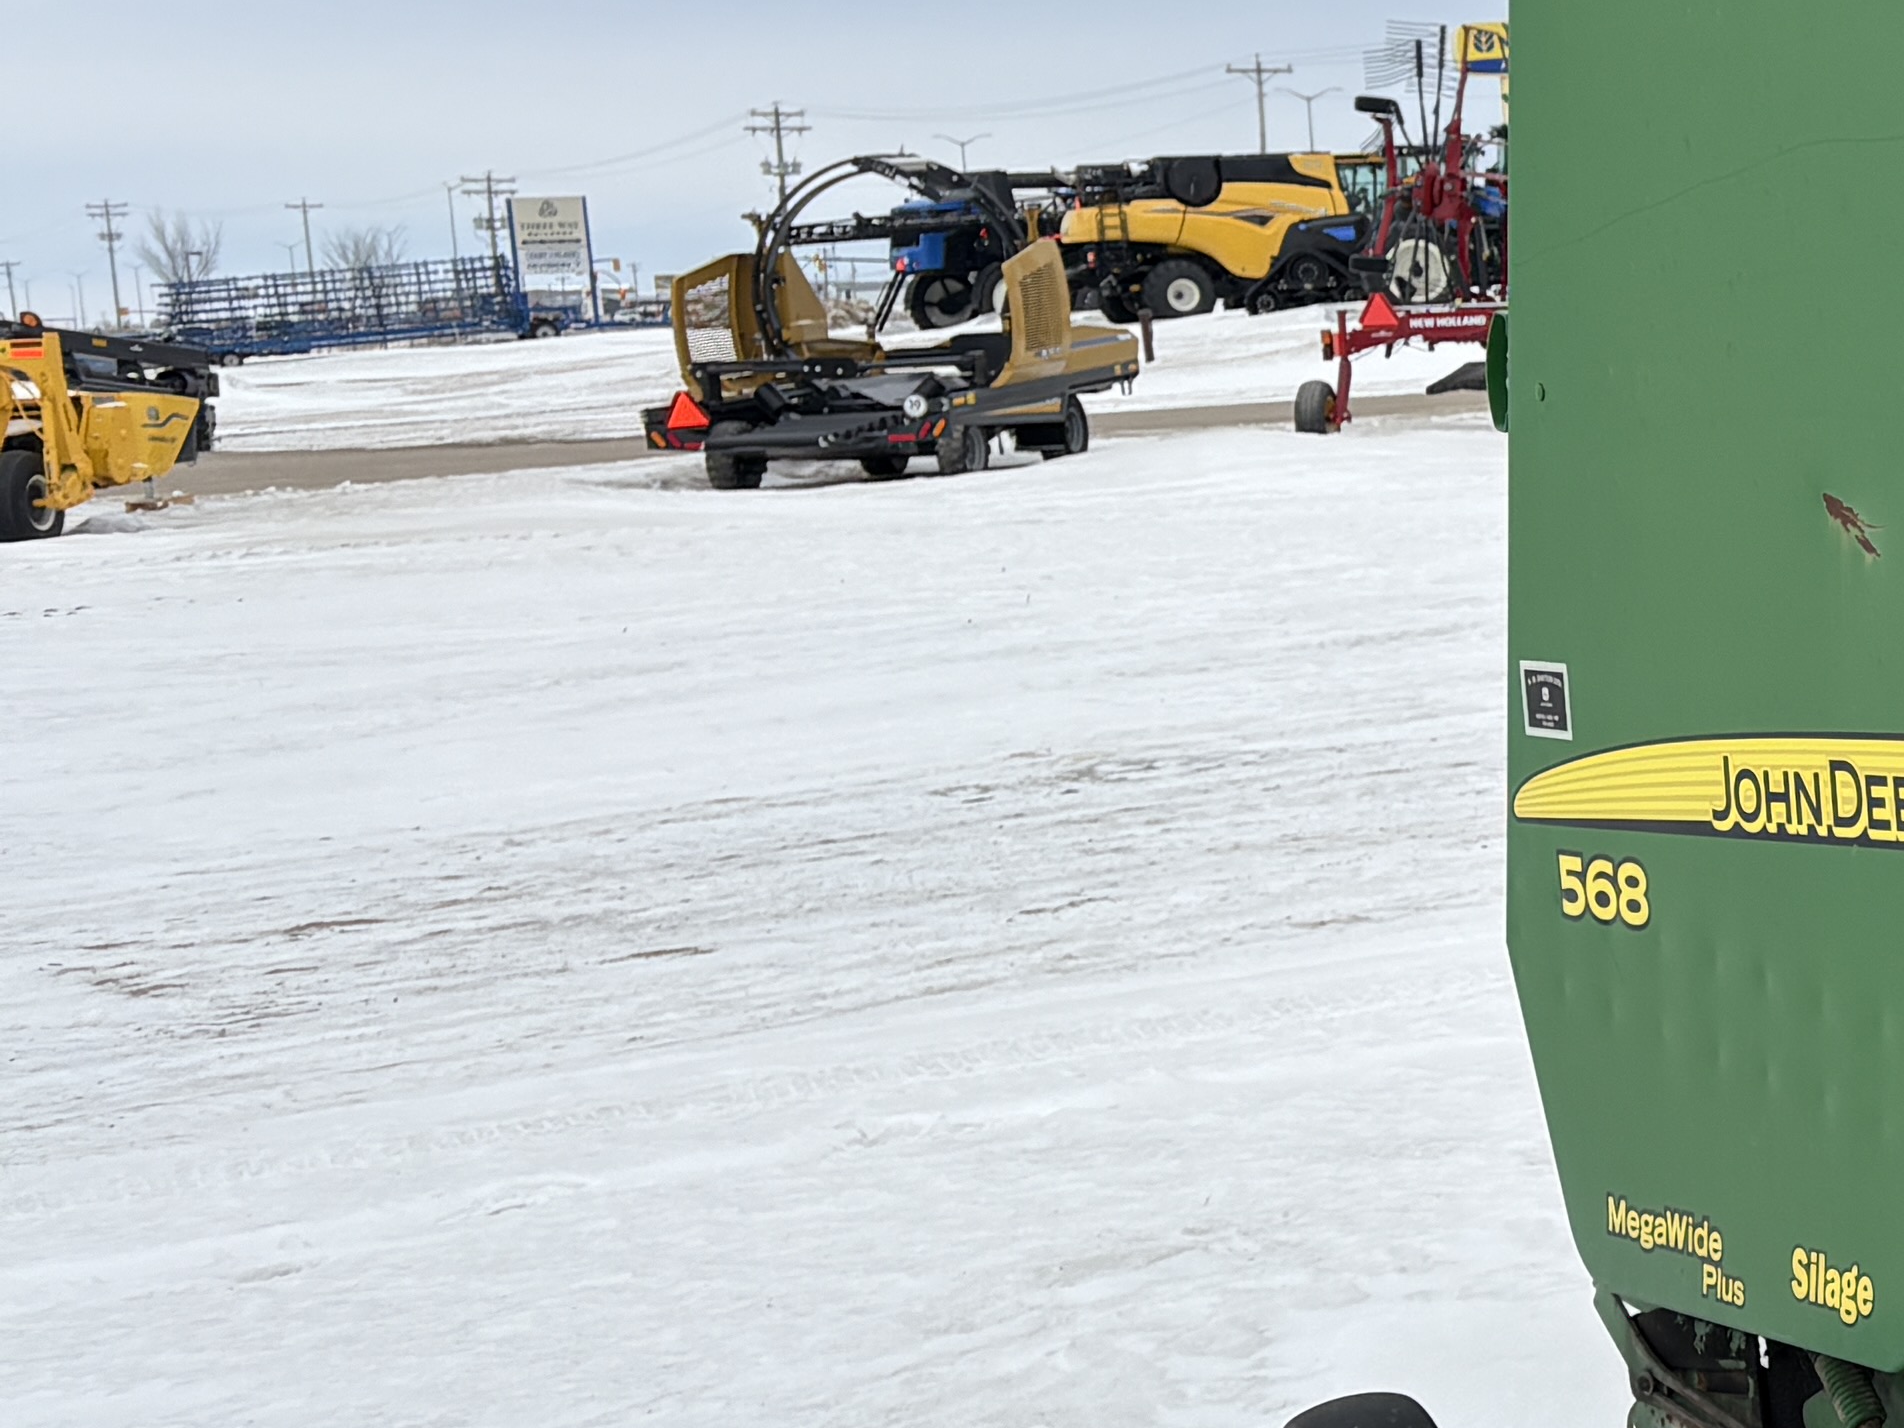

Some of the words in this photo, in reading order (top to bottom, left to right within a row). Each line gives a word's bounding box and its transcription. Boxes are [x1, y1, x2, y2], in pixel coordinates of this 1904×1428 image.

[1409, 316, 1435, 329] NEW
[1436, 315, 1487, 328] HOLLAND
[1712, 755, 1822, 828] JOHN
[1556, 853, 1650, 928] 568
[1606, 1194, 1724, 1263] MegaWide
[1702, 1263, 1746, 1308] Plus
[1790, 1246, 1876, 1326] Silage
